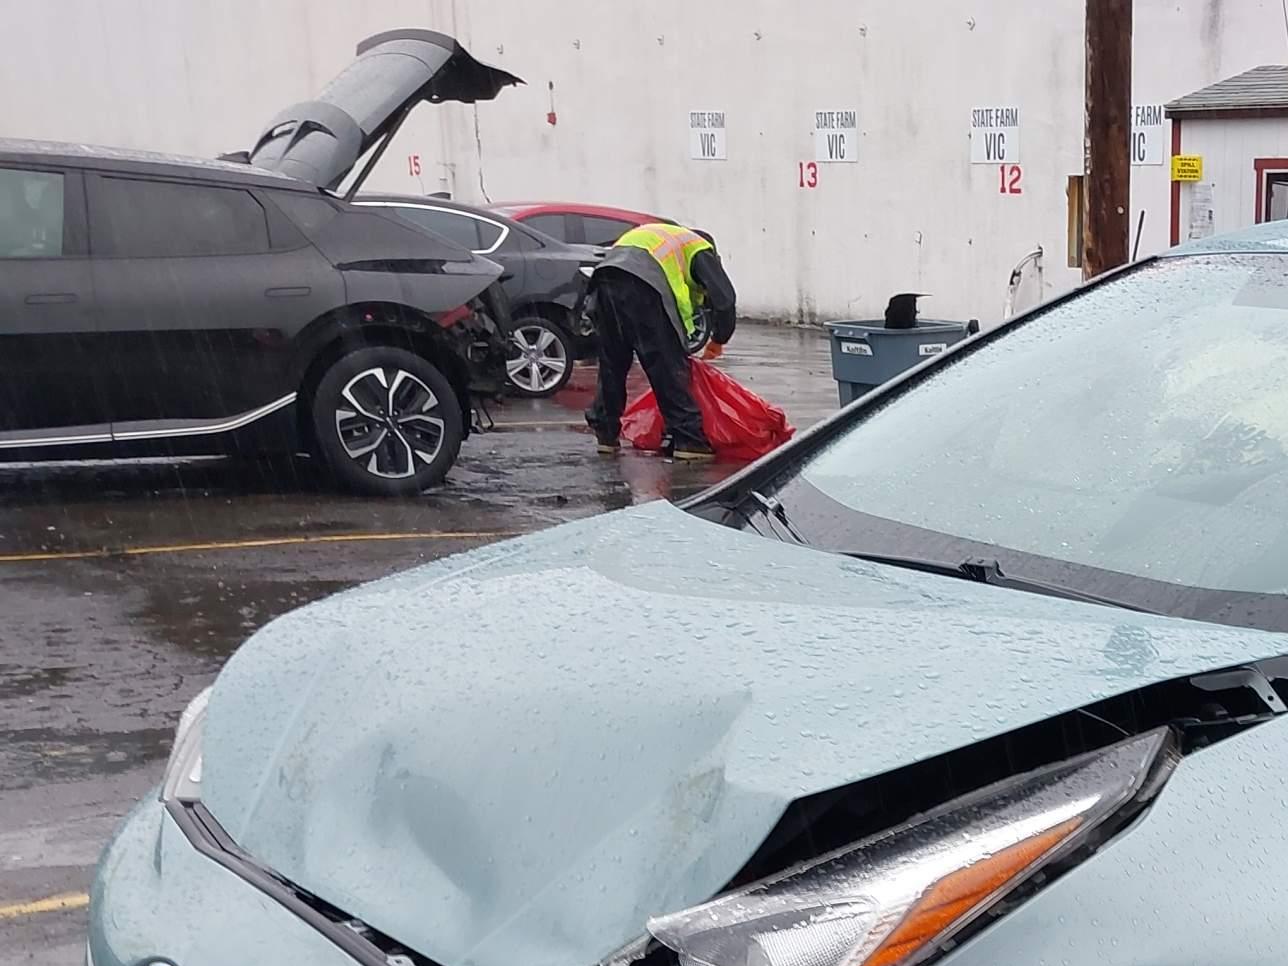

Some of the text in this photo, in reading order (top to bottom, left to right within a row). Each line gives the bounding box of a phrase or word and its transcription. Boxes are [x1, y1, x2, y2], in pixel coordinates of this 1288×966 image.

[690, 112, 725, 128] STATE FARM
[815, 111, 856, 129] STATE FARM
[972, 108, 1018, 127] STATE FARM
[1135, 105, 1162, 126] FARM
[700, 133, 716, 157] VIC
[827, 133, 845, 160] VIC
[984, 132, 1005, 161] VIC
[1132, 132, 1146, 162] IC
[408, 155, 421, 177] 15
[799, 161, 818, 188] 13
[999, 165, 1022, 194] 12
